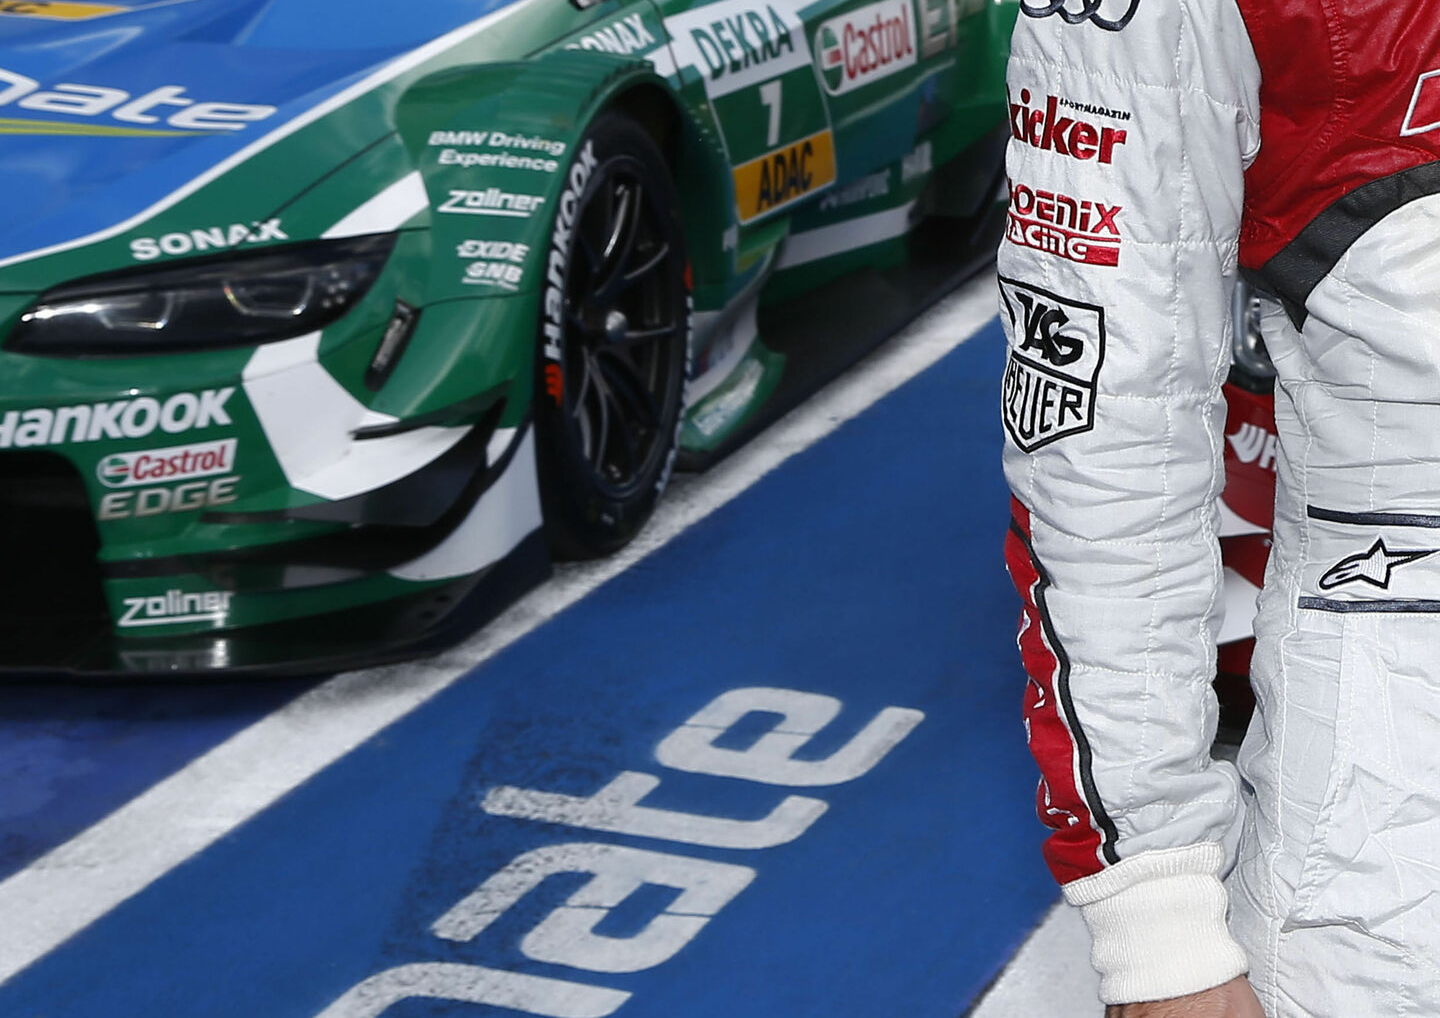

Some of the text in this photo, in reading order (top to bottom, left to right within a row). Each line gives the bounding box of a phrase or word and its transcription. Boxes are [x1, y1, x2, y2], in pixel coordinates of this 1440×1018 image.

[565, 13, 656, 55] ONAX
[690, 4, 794, 81] DEKRA
[842, 3, 913, 81] Castrol
[428, 131, 566, 156] BMW Driving
[438, 148, 559, 172] Experience
[757, 141, 814, 213] ADAC
[1008, 182, 1123, 236] OENIX
[131, 217, 289, 261] SONAX
[132, 444, 227, 481] Castrol
[96, 475, 242, 521] EDGE
